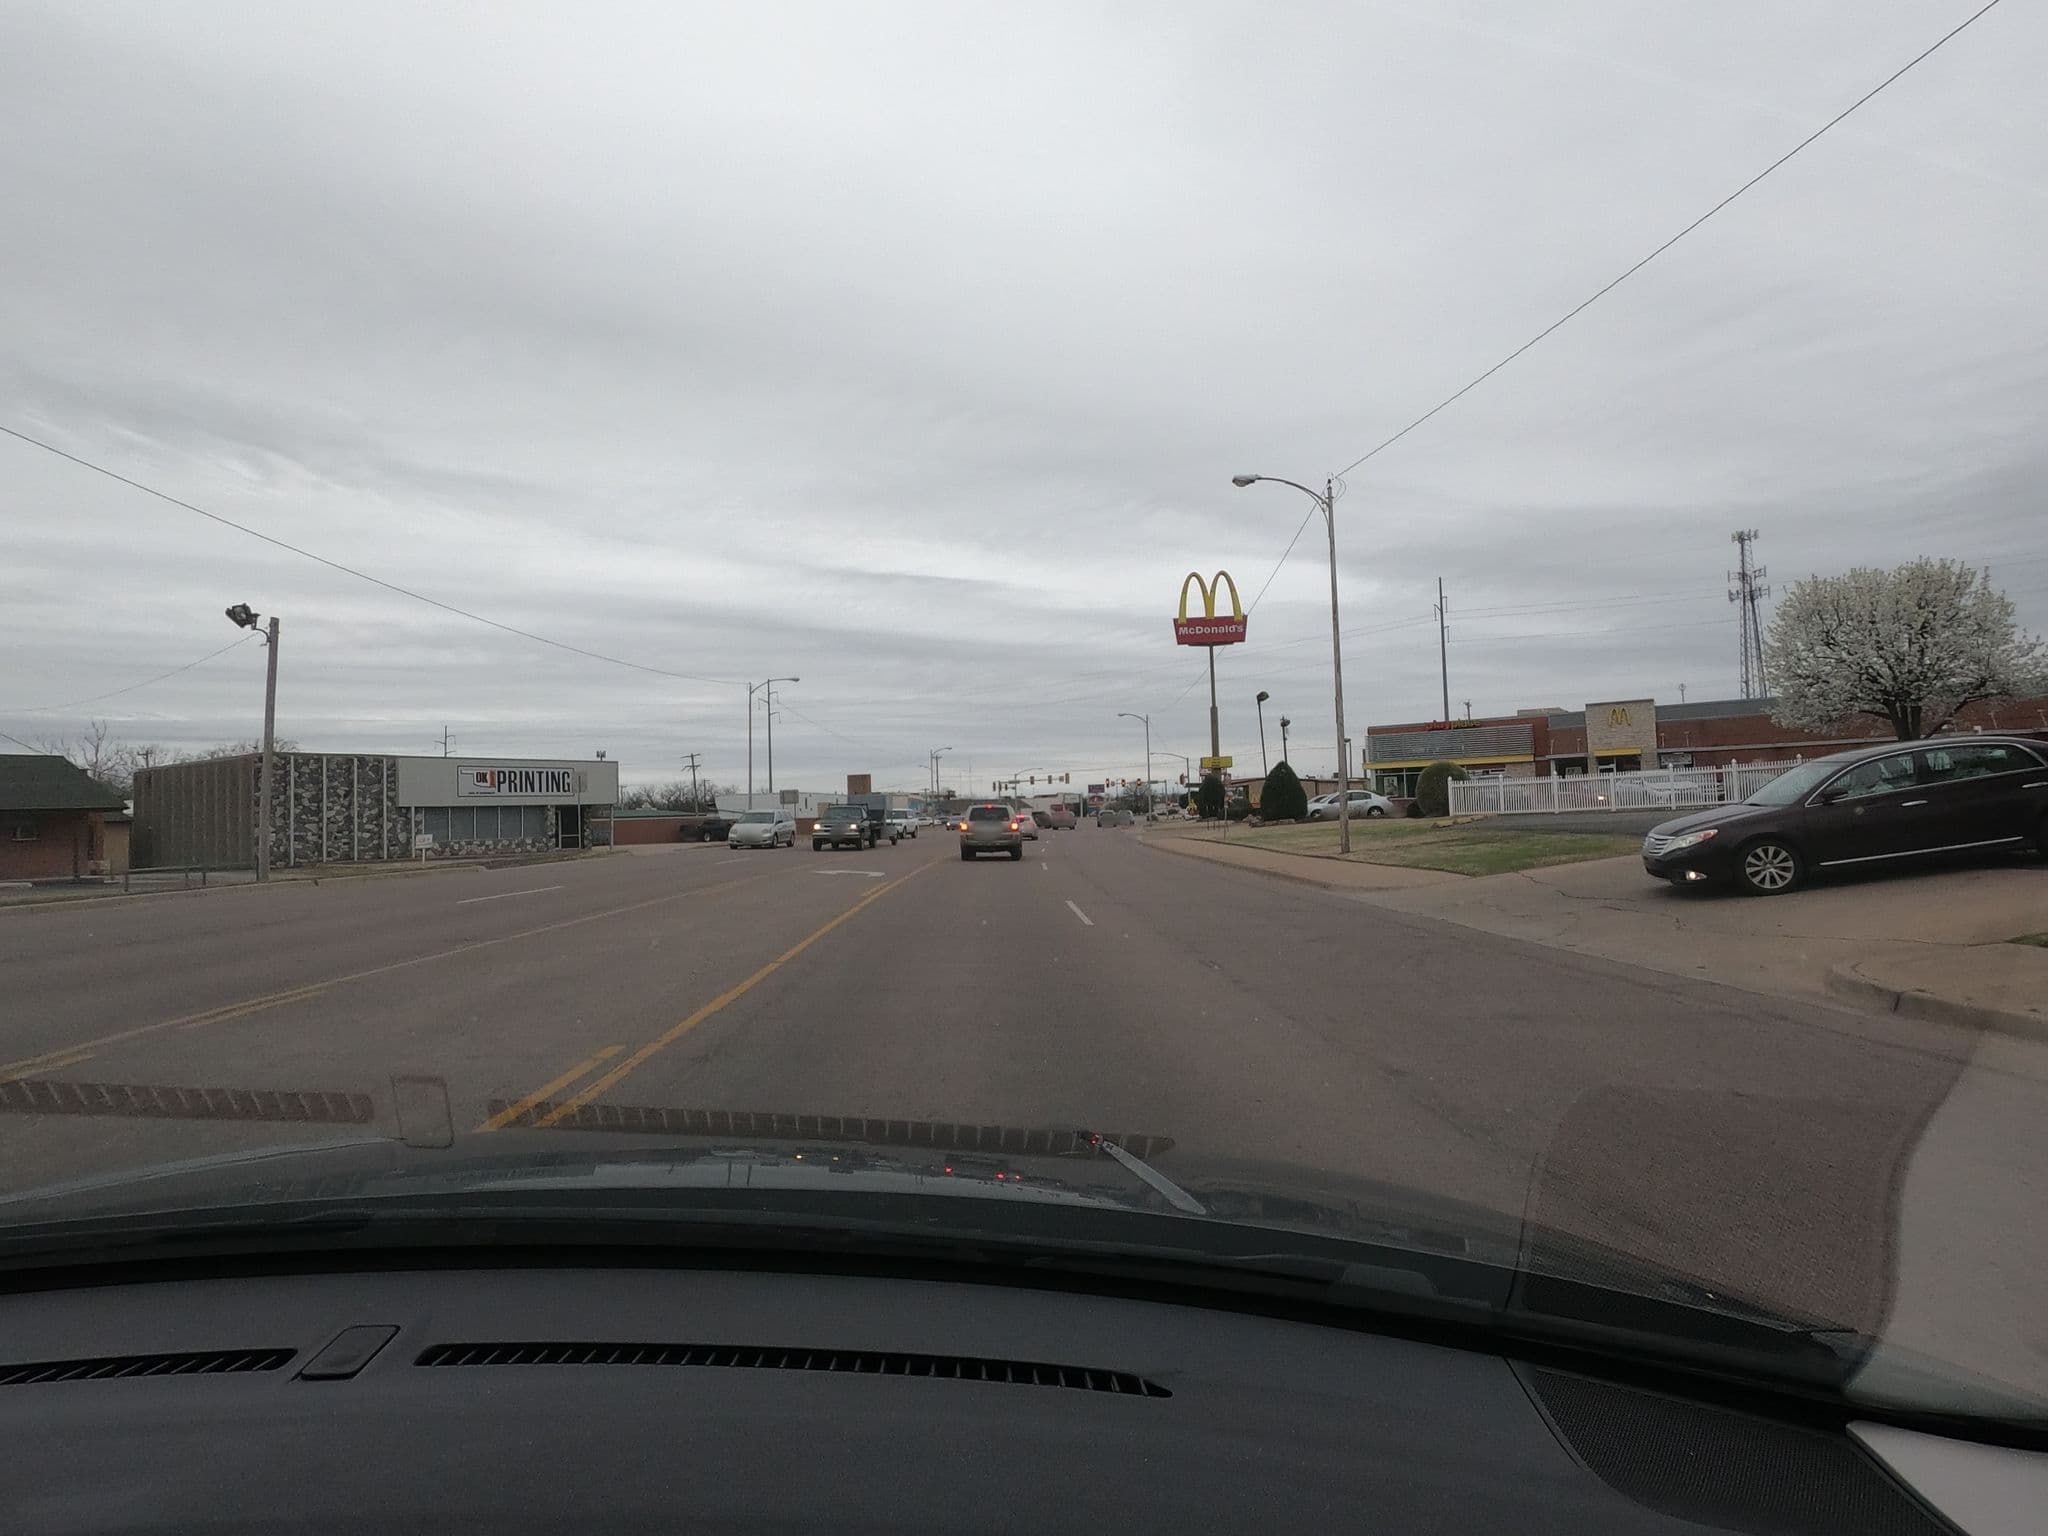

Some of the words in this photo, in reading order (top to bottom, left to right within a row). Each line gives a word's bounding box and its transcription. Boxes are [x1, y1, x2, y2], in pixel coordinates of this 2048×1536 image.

[1179, 625, 1243, 635] McDonald's
[476, 772, 488, 783] OK
[497, 770, 571, 793] PRINTING
